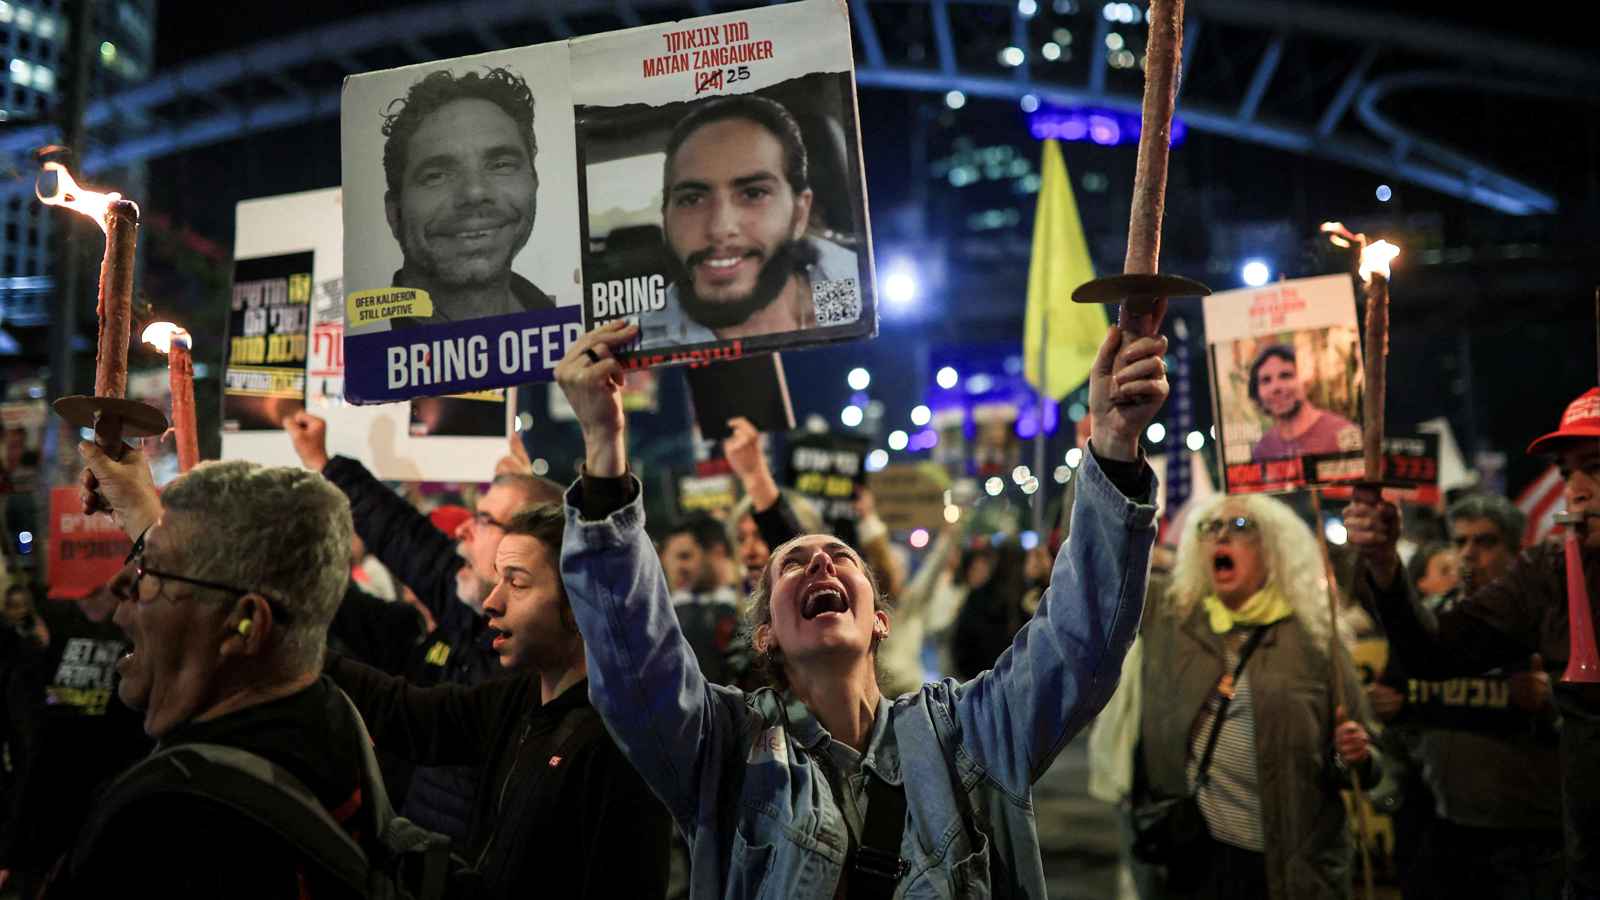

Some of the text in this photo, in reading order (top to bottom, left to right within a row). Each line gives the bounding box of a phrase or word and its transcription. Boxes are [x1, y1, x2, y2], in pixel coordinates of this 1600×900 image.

[722, 21, 749, 45] מתן
[643, 40, 774, 78] MATAN ZANGAUKER
[727, 66, 751, 83] 25
[355, 290, 416, 309] OFER KALDERON
[591, 273, 666, 319] BRING
[359, 304, 413, 321] STILL CAPTIVE
[387, 334, 489, 390] BRING
